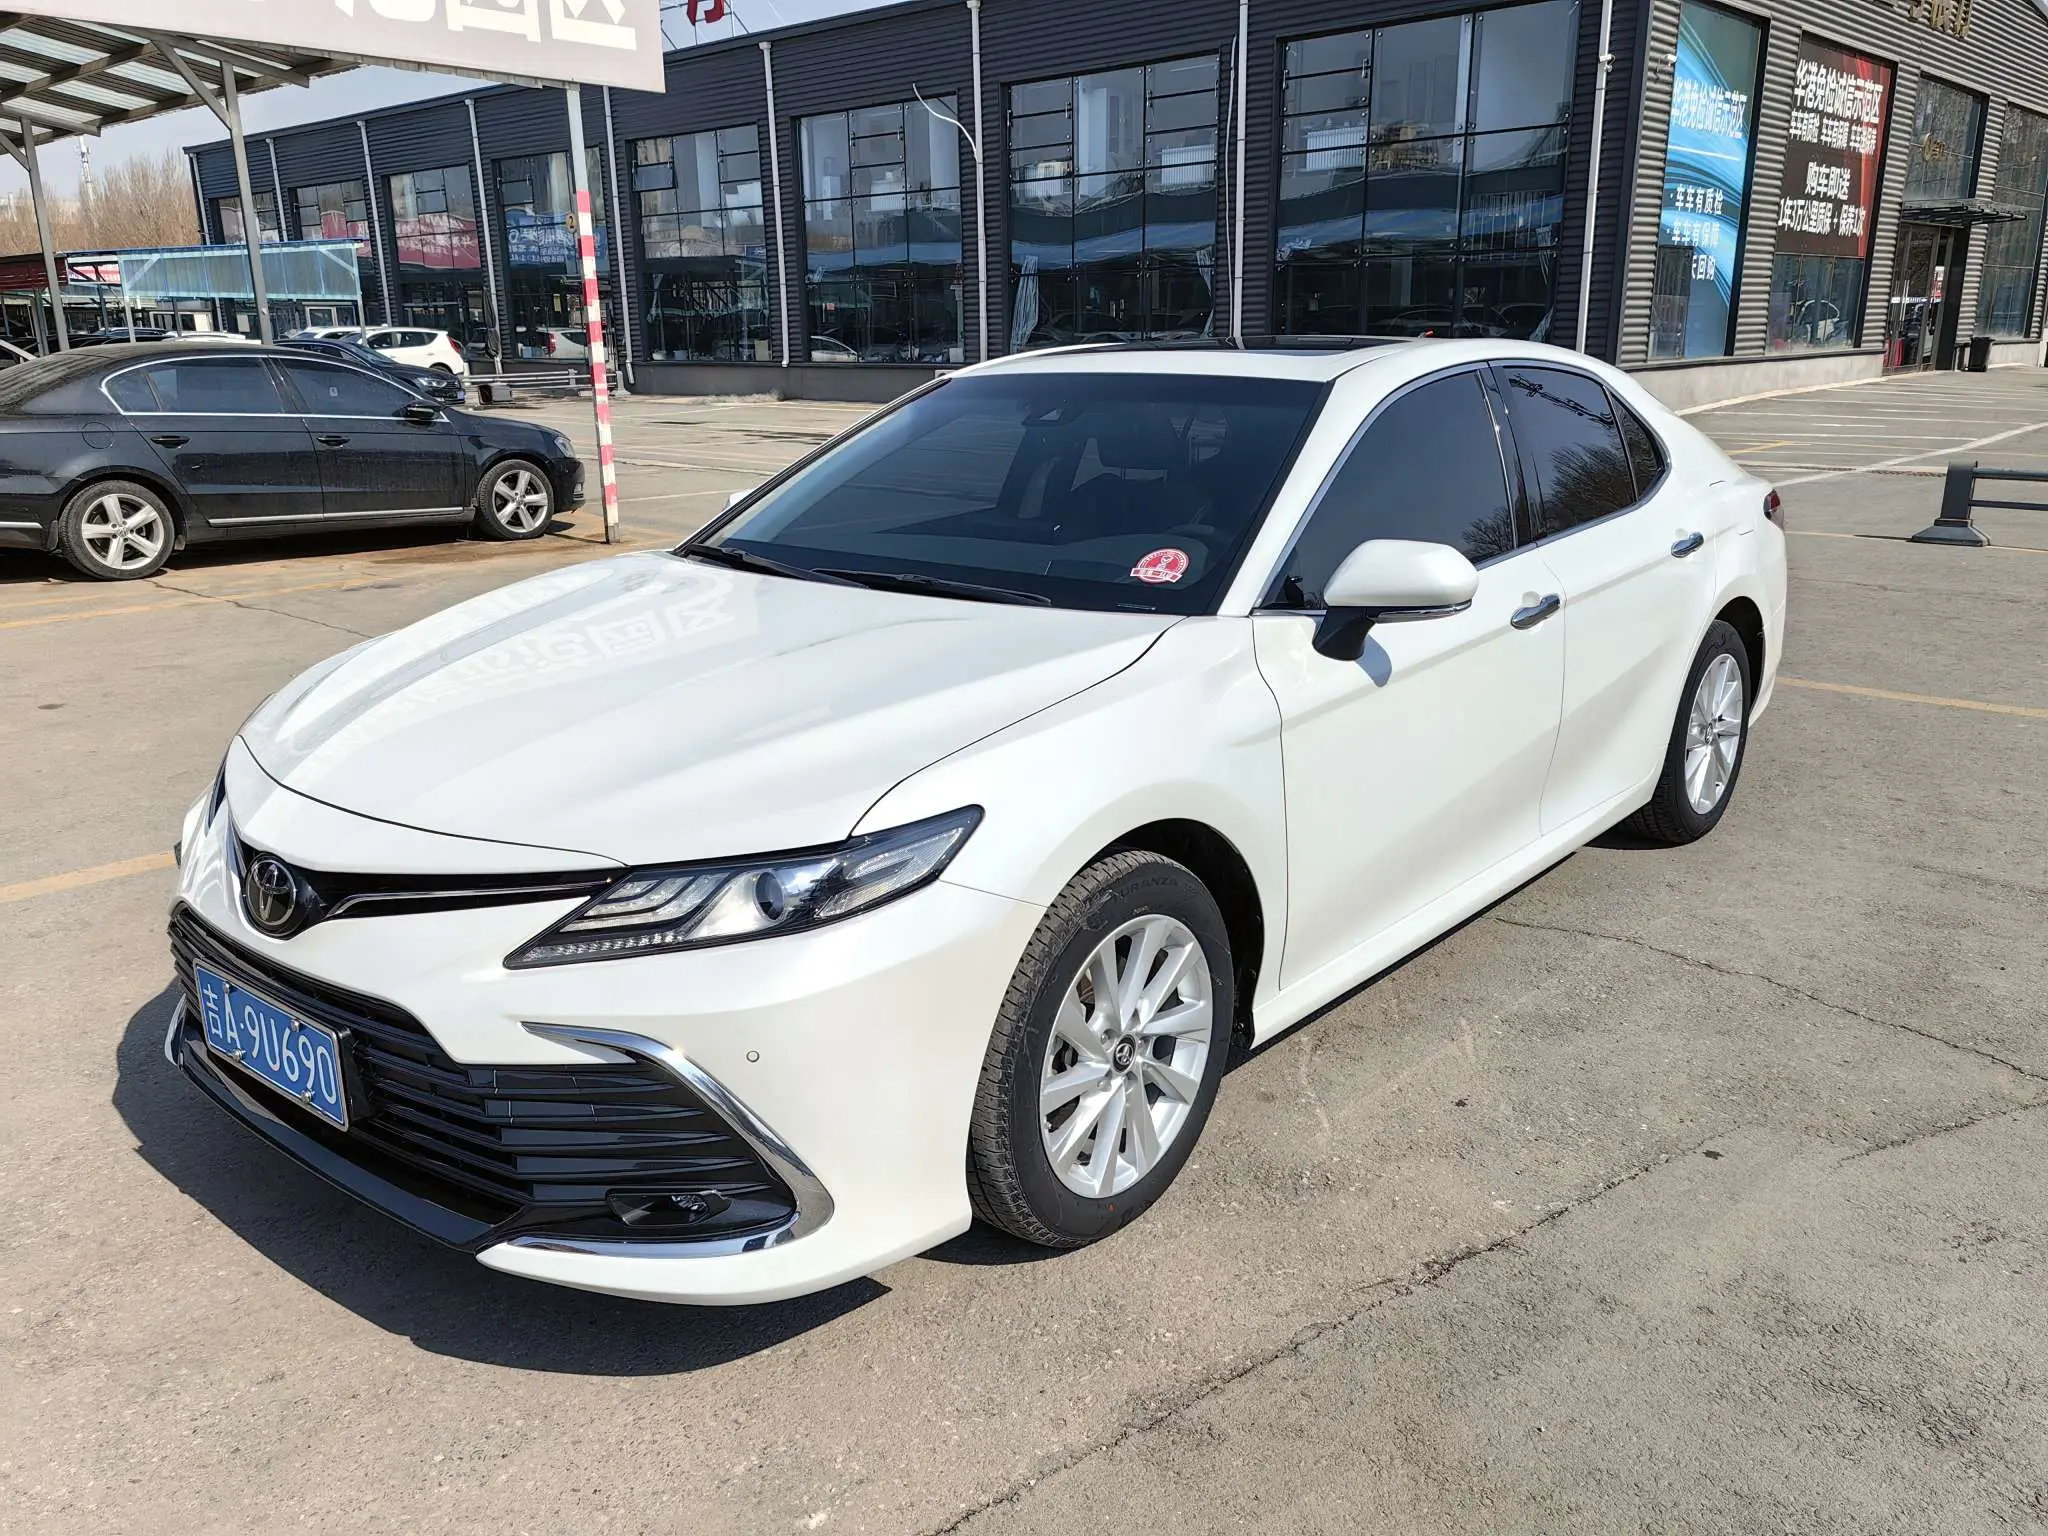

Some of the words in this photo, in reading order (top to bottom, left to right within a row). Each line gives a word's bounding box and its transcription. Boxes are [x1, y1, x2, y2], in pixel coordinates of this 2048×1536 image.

[1794, 58, 1884, 124] 华港免检诚信示范区
[1674, 183, 1724, 215] 车车有质检
[1804, 161, 1851, 201] 购车即送
